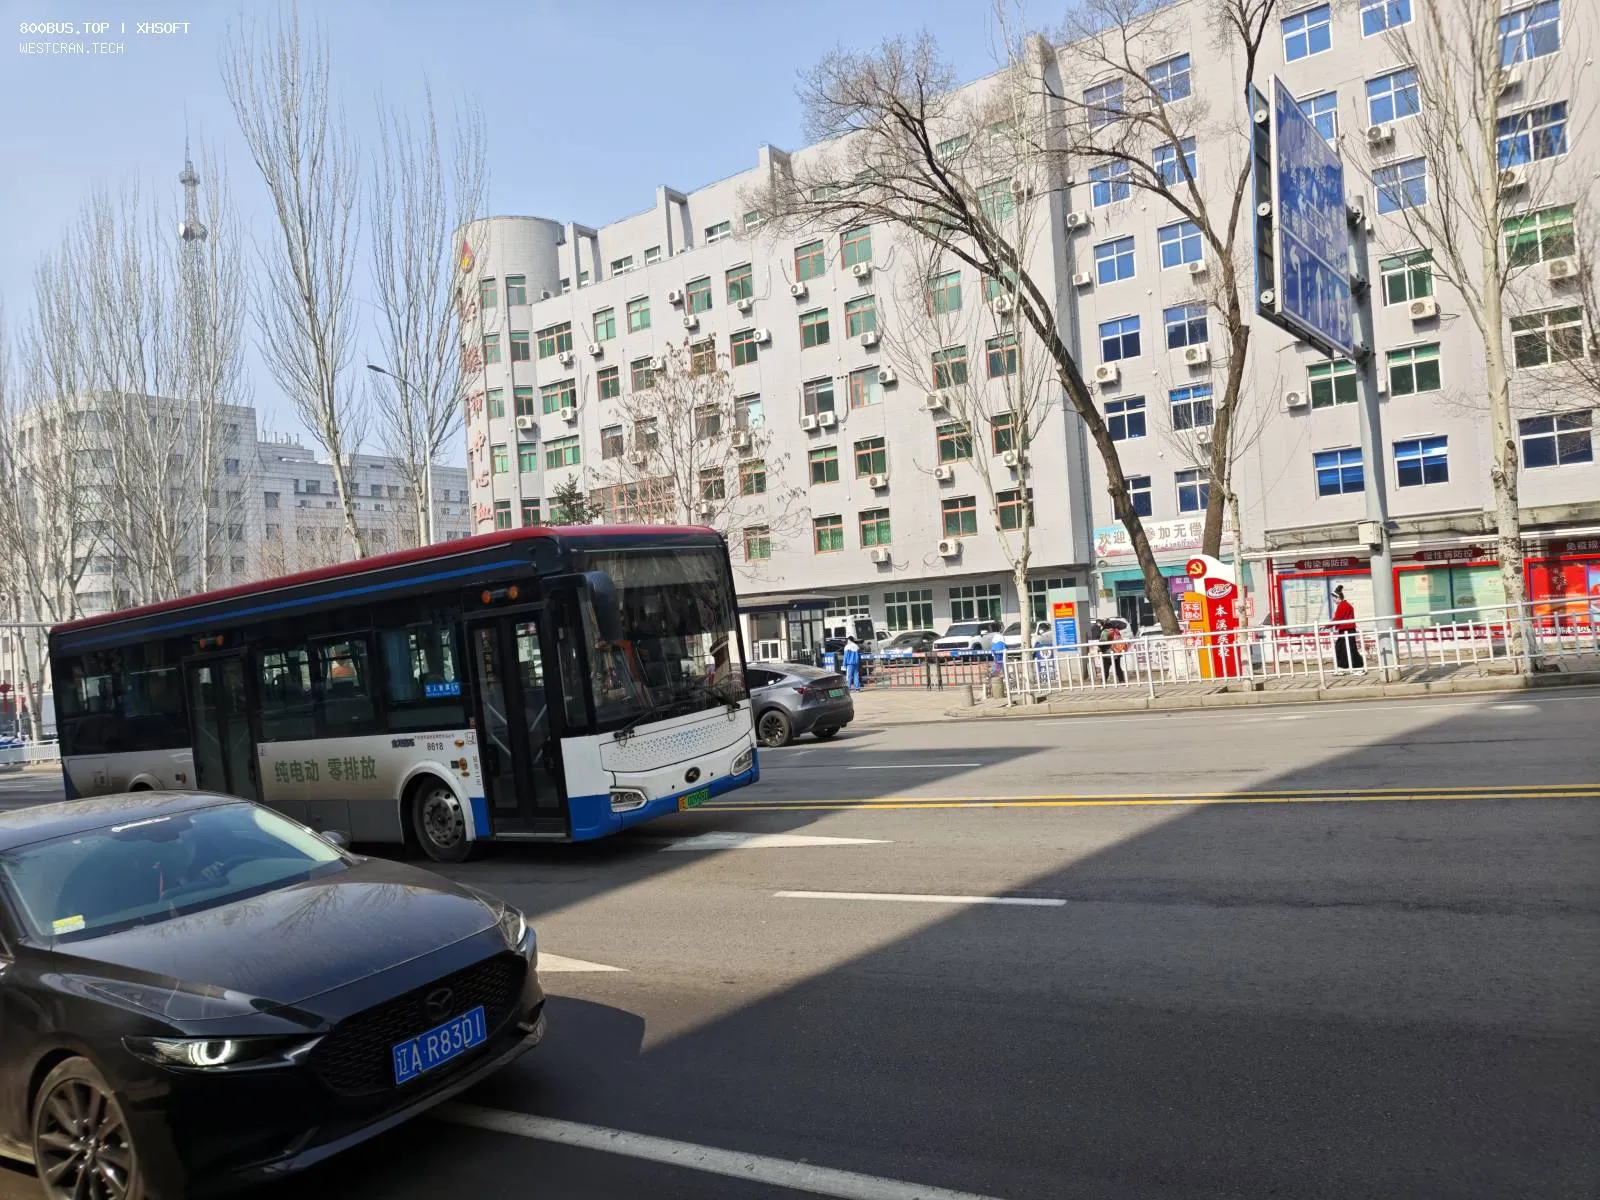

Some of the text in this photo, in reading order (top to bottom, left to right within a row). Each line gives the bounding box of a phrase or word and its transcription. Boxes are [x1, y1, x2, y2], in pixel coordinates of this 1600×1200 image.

[274, 755, 377, 783] 纯电动 零排放
